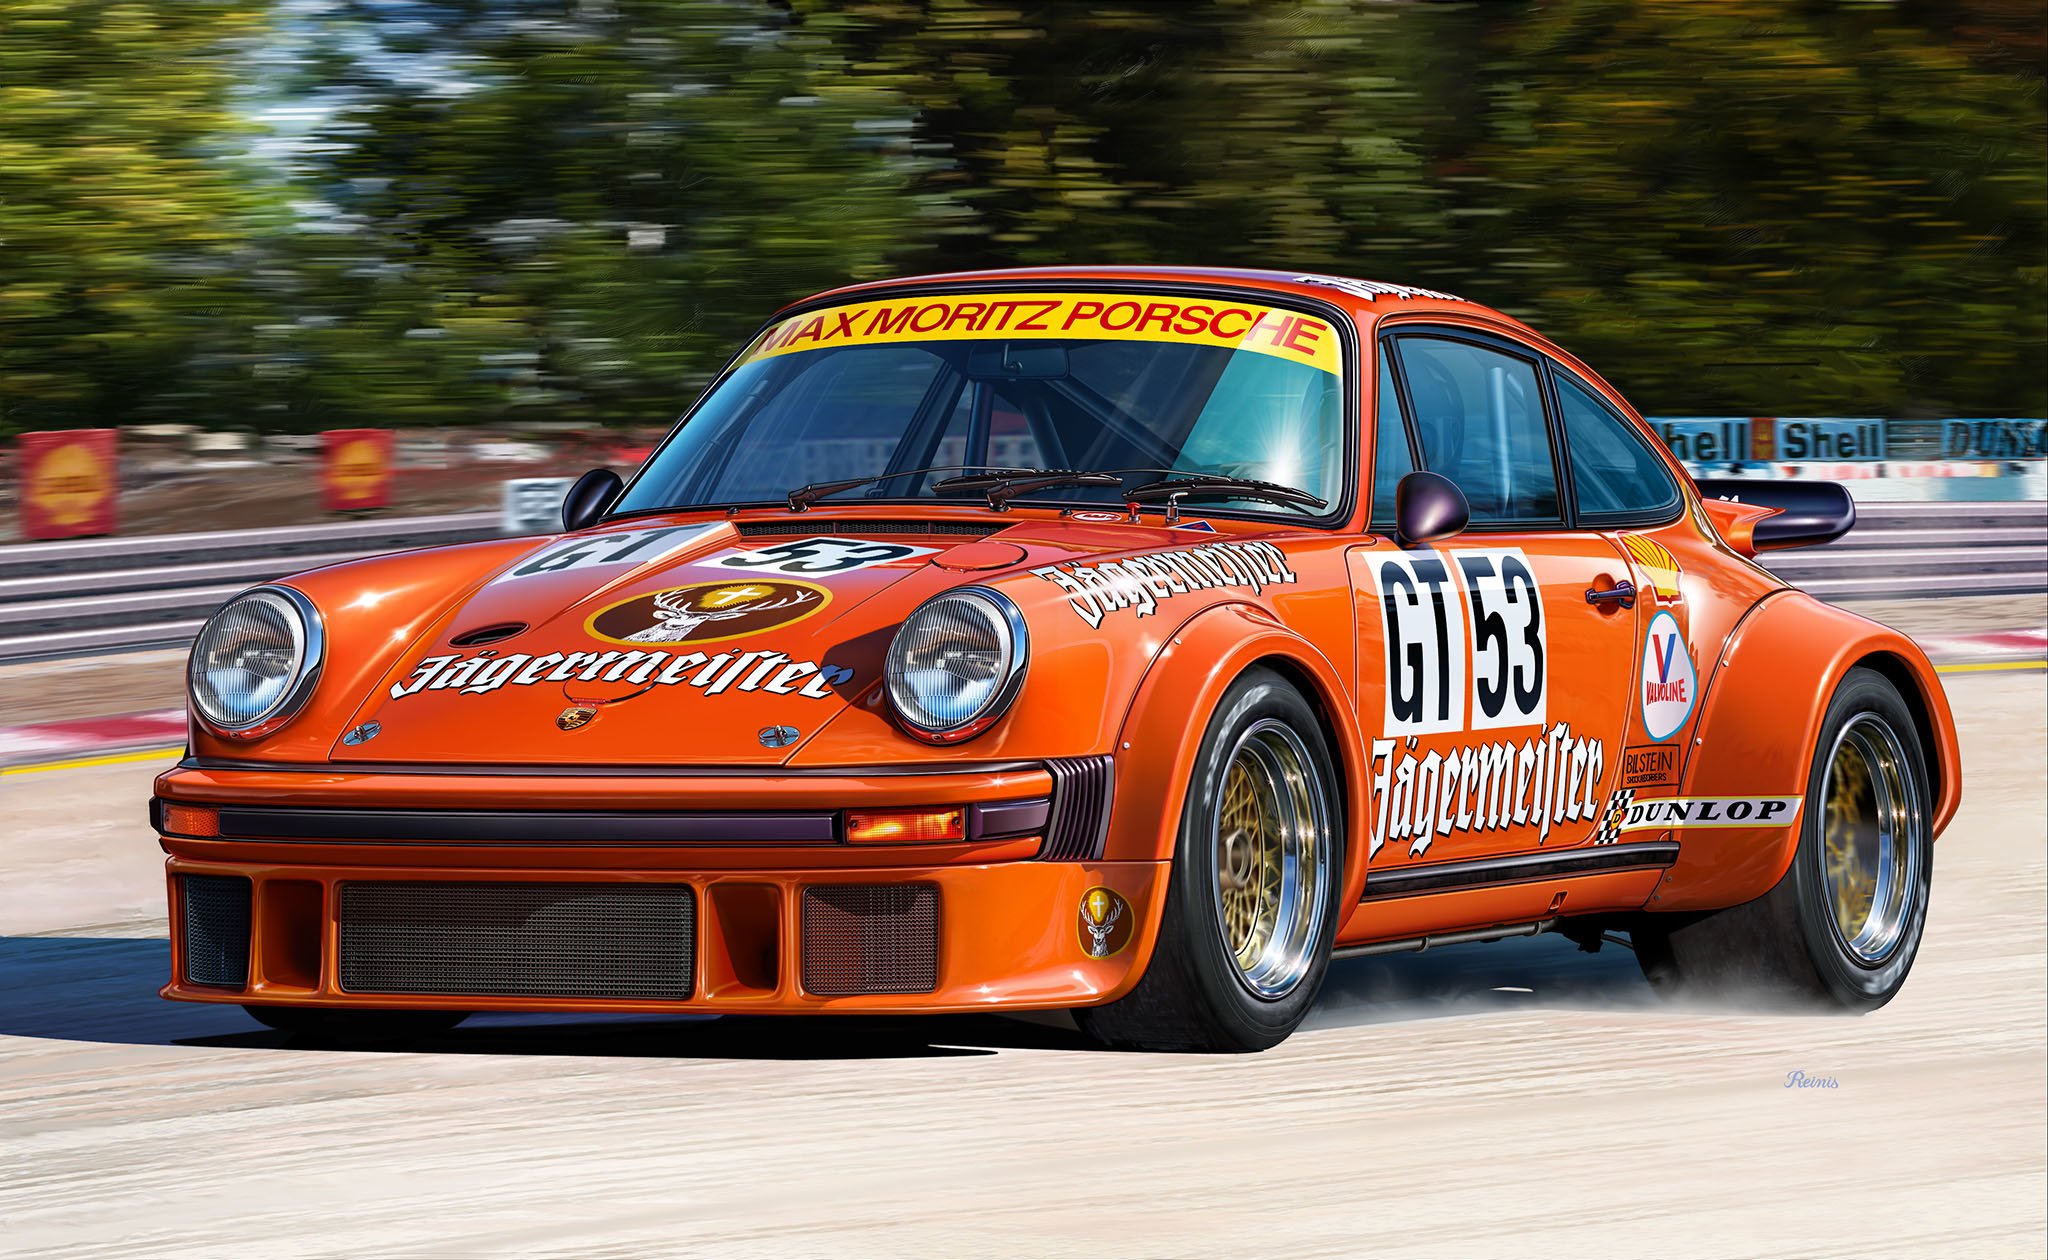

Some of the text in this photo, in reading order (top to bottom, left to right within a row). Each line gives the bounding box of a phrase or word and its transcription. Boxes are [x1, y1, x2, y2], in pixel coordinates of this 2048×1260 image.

[752, 300, 1328, 357] MAX MORITZ PORSCHE
[1783, 422, 1878, 459] Shell
[513, 523, 915, 576] GT 53
[1380, 555, 1544, 723] GT 53
[1646, 678, 1687, 706] VALVOLINE
[1626, 751, 1672, 774] BILSTEIN
[1628, 801, 1787, 825] DUNLOP
